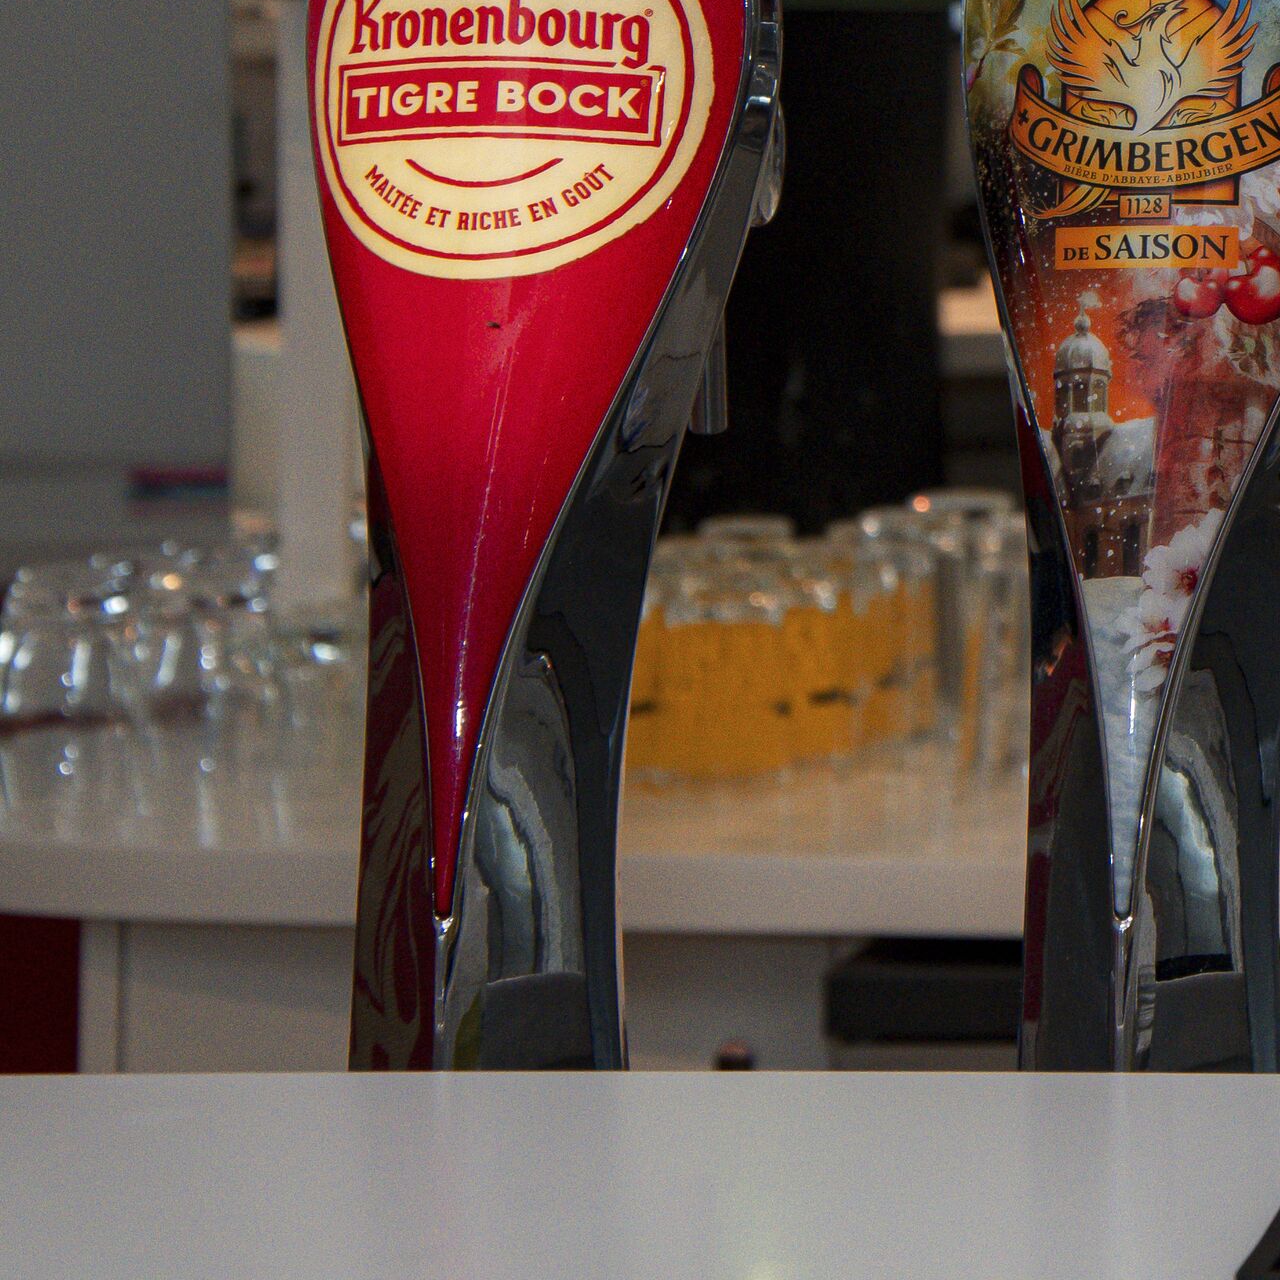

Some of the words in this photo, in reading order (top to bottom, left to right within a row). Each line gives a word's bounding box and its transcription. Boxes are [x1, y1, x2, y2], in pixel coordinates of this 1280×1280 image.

[352, 80, 479, 120] TIGRE
[496, 81, 641, 120] BOCK
[1064, 163, 1098, 181] BIÈRE
[364, 164, 424, 221] MALTÉE
[425, 207, 453, 230] ET
[457, 208, 522, 231] RICHE
[529, 197, 559, 223] EN
[562, 163, 616, 207] GOÛT
[1126, 196, 1163, 217] 1128
[1063, 246, 1090, 262] DE
[1094, 232, 1230, 262] SAISON
